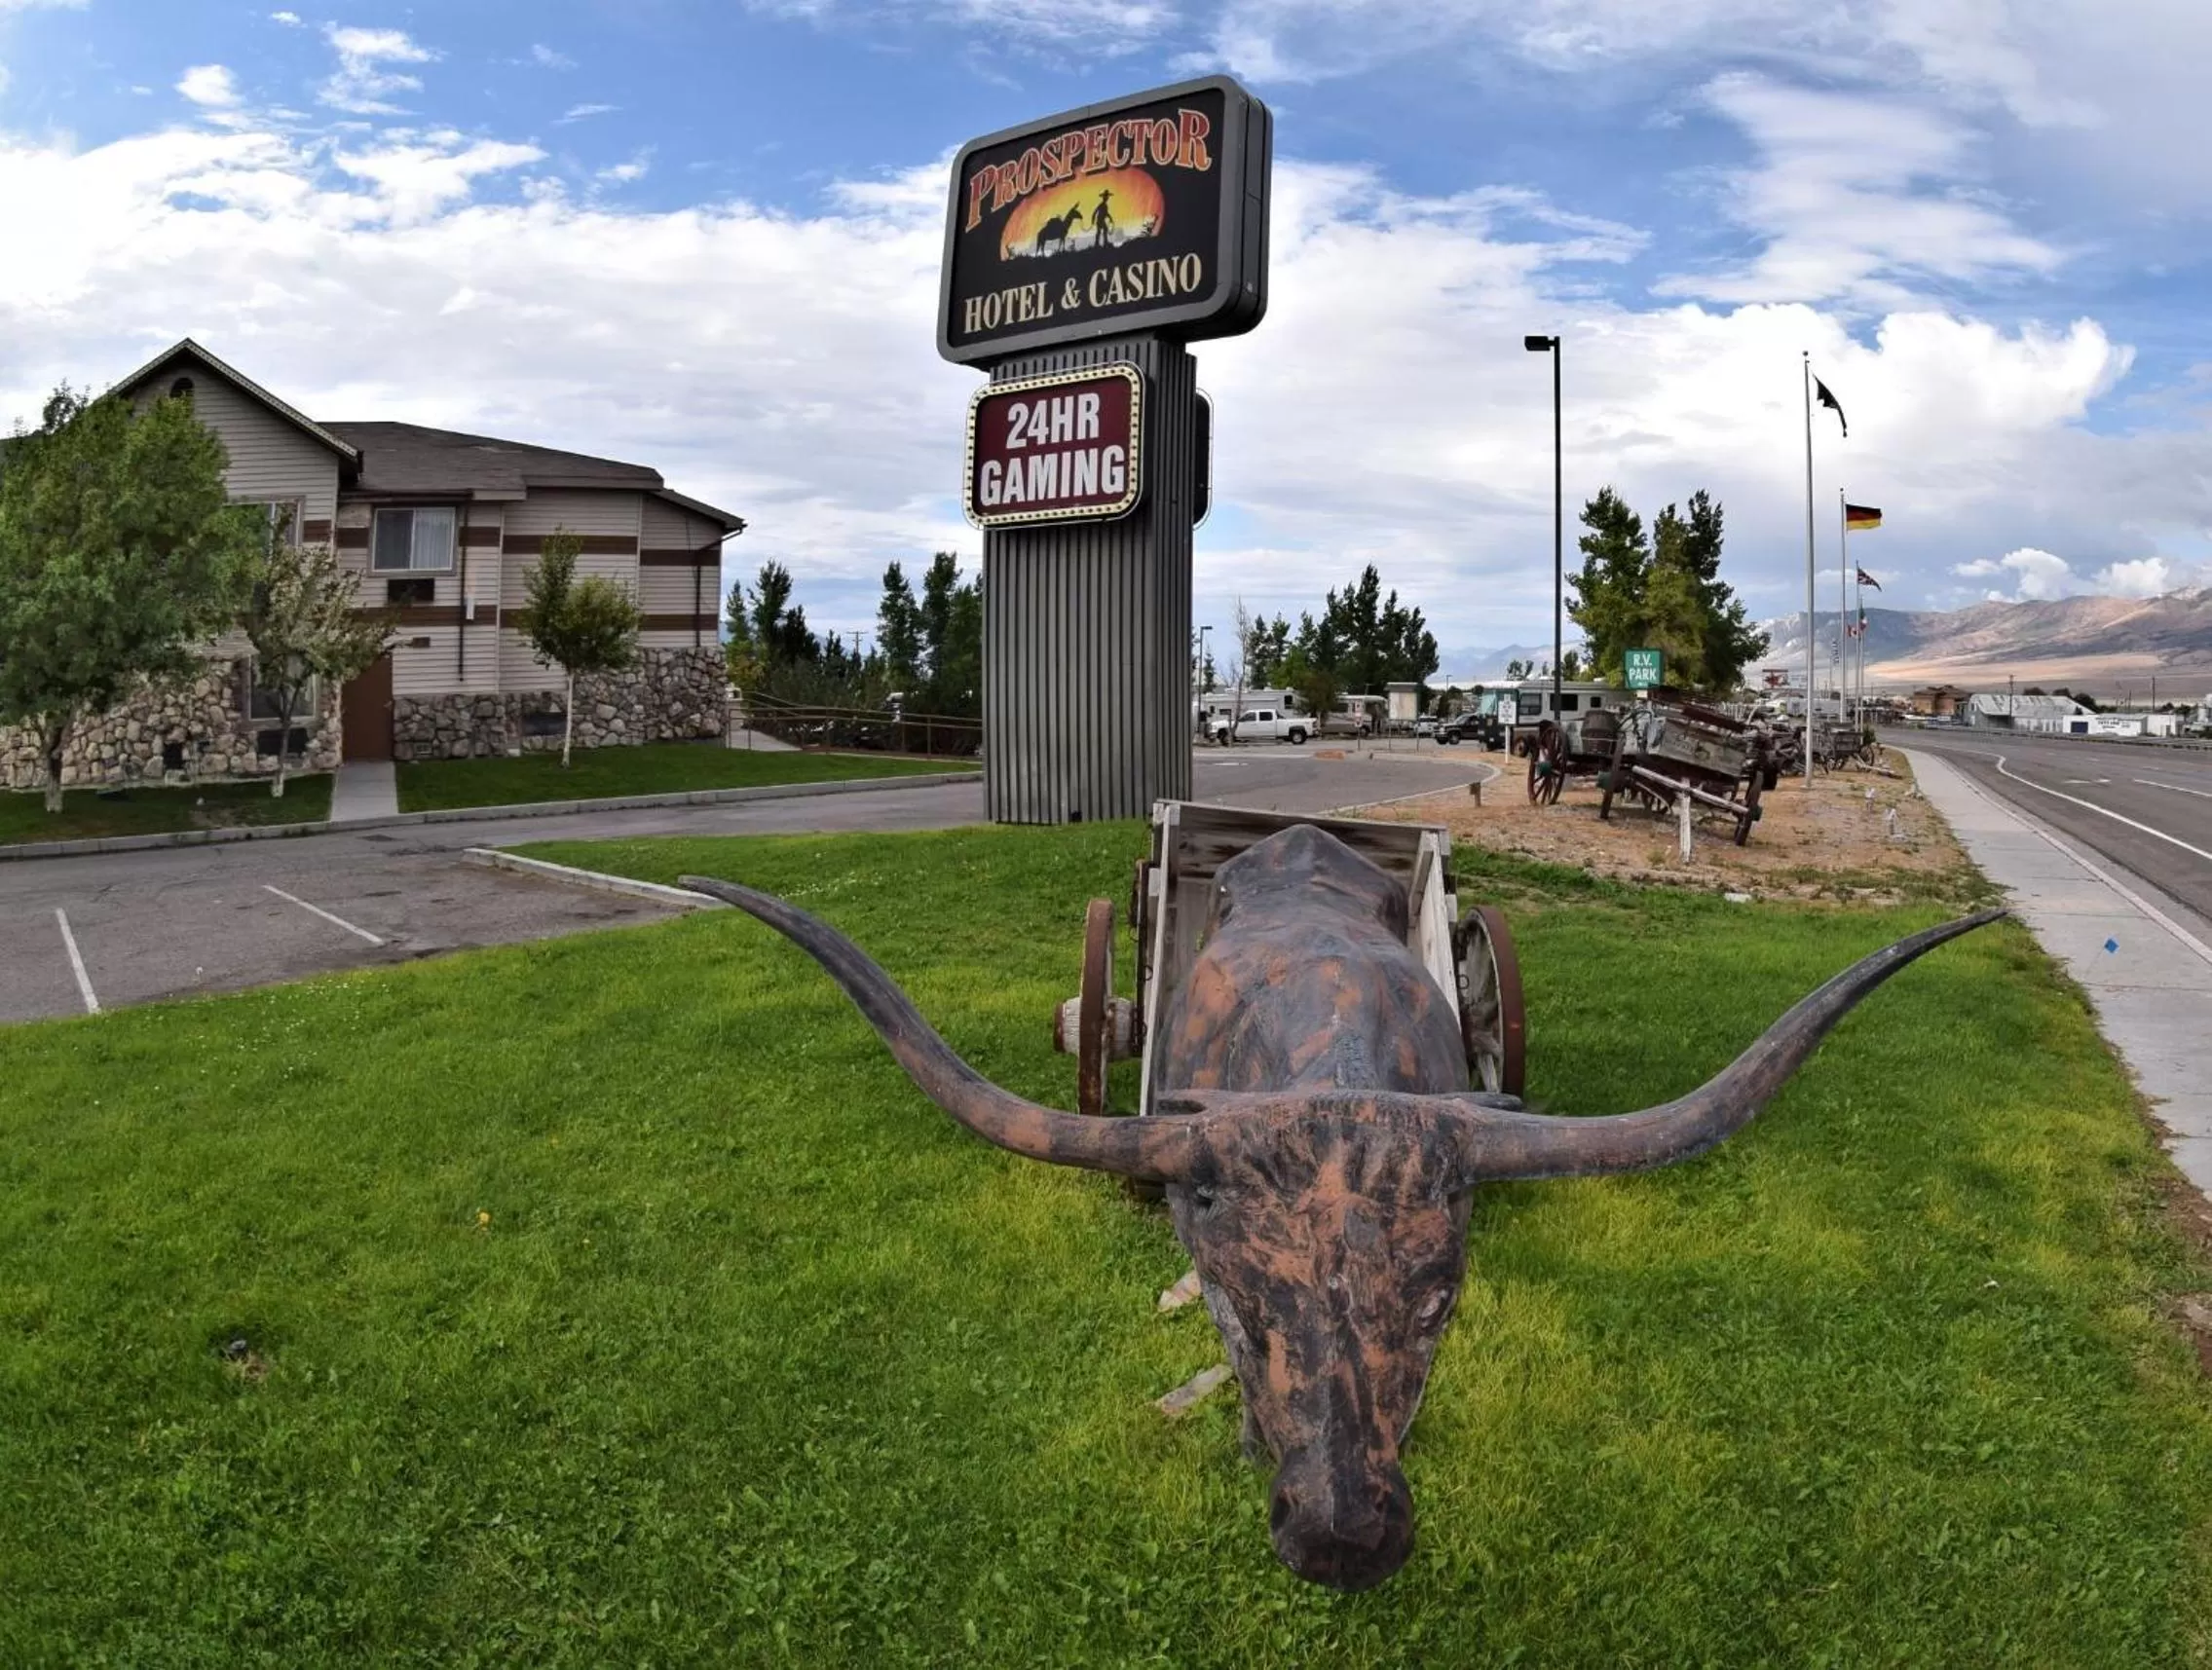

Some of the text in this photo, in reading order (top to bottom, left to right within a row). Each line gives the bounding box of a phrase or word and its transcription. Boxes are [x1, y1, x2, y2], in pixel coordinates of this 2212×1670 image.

[964, 108, 1214, 234] PROSPECTOR
[963, 253, 1202, 334] HOTEL & CASINO
[1006, 392, 1101, 449] 24HR
[980, 445, 1125, 506] GAMING
[1629, 667, 1657, 681] PARK
[1632, 653, 1653, 667] R.V.
